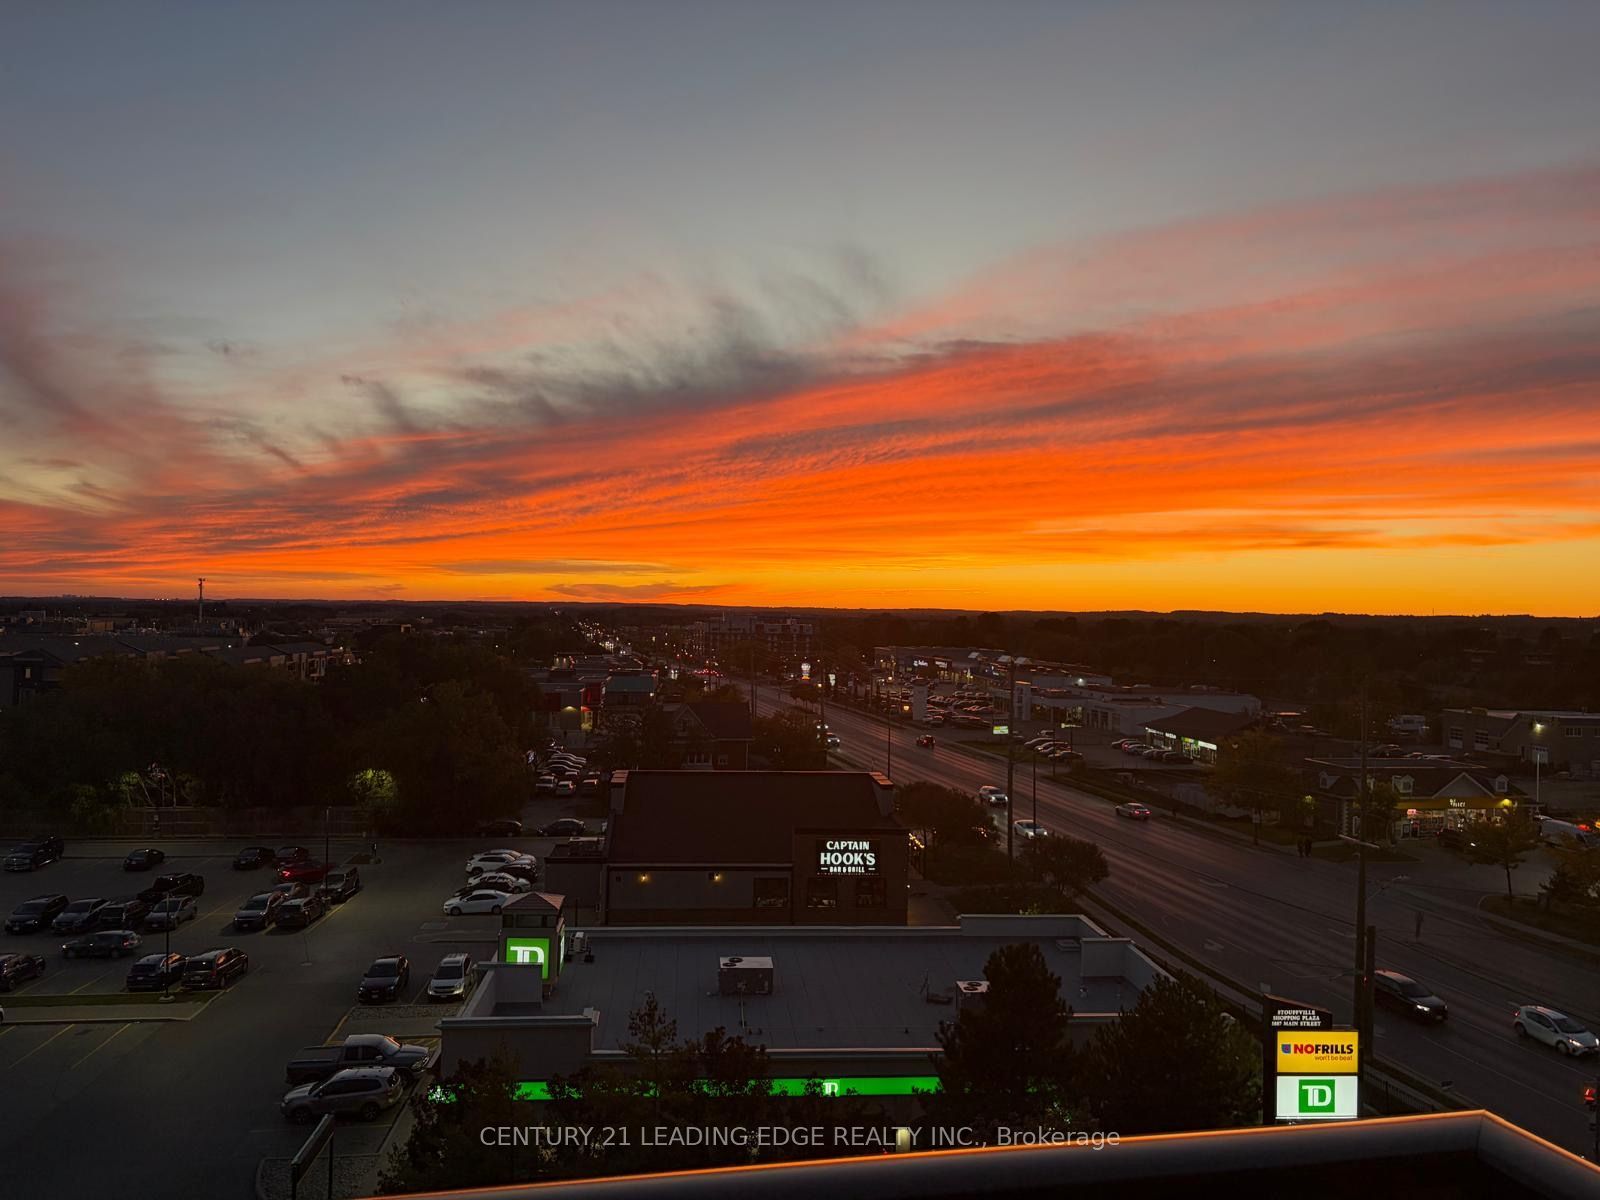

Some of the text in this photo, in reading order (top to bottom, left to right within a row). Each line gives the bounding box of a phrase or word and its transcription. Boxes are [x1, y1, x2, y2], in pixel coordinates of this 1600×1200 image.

[826, 841, 870, 850] CAPTAIN
[820, 852, 876, 866] HOOK'S
[510, 946, 545, 964] TD
[823, 1082, 838, 1096] TD
[1301, 1085, 1332, 1107] TD
